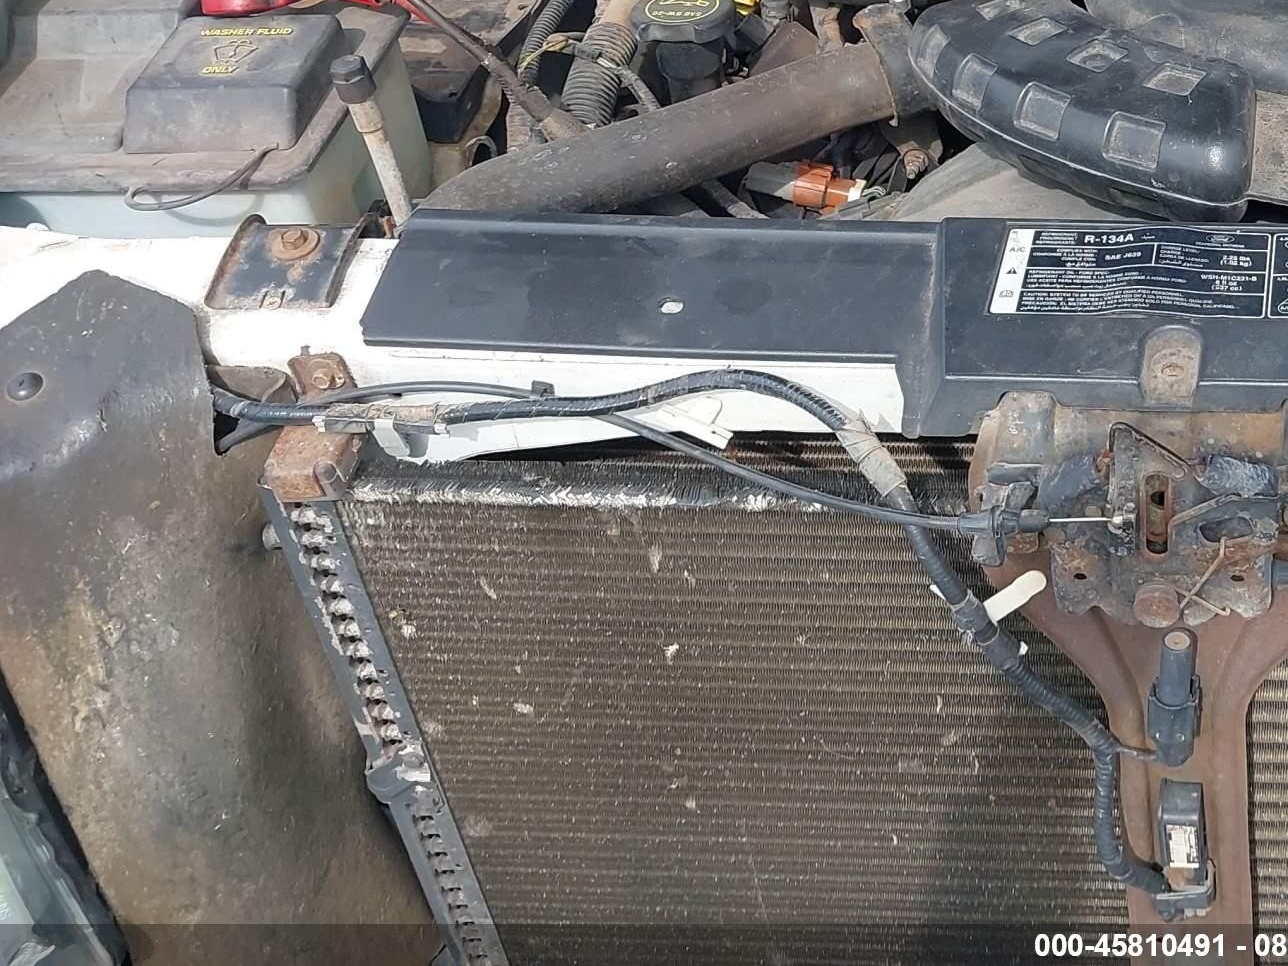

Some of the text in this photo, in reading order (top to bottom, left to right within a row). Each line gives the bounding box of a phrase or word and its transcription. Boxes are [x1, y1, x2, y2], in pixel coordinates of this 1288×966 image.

[200, 27, 294, 36] WASHER FLUID
[201, 66, 238, 74] ONLY
[1084, 234, 1134, 244] R-134A
